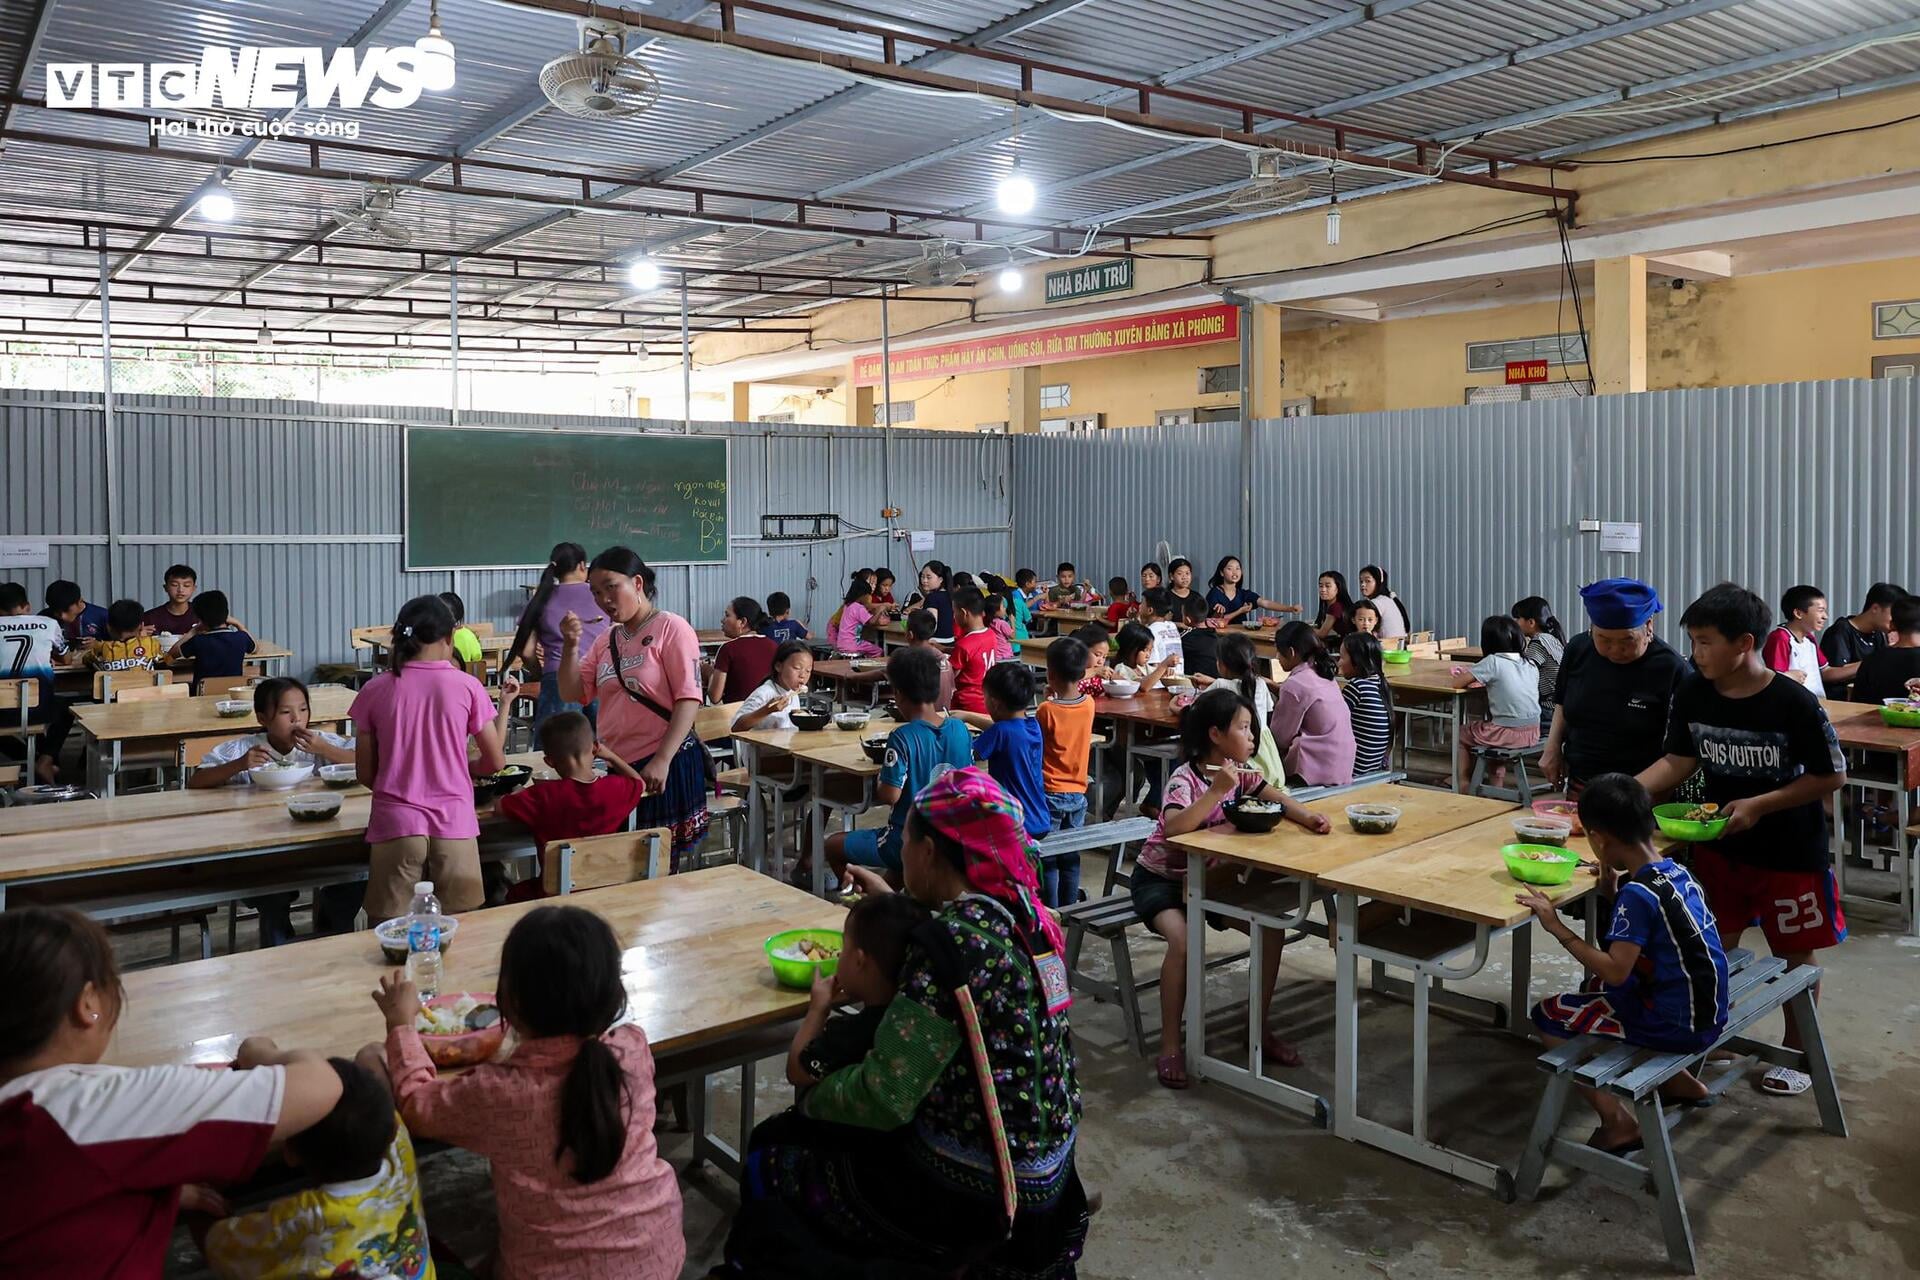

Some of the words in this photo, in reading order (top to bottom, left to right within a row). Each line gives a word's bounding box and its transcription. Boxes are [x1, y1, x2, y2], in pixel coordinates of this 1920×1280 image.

[1048, 272, 1073, 298] NHÀ
[1074, 267, 1100, 293] BÁN
[1103, 261, 1128, 288] TRÚ
[1064, 335, 1078, 352] TAY
[1079, 331, 1112, 351] THƯỜNG
[1113, 323, 1143, 347] XUYÊN
[1144, 319, 1170, 342] BẰNG
[1172, 319, 1186, 340] XÀ
[1187, 313, 1225, 337] PHÒNG!
[1508, 365, 1526, 380] NHÀ
[1528, 365, 1546, 379] KHO
[3, 634, 34, 675] 7
[1700, 738, 1727, 766] LOUIS
[1728, 743, 1780, 769] VUITTON
[1609, 916, 1630, 938] 12
[1774, 891, 1824, 934] 23
